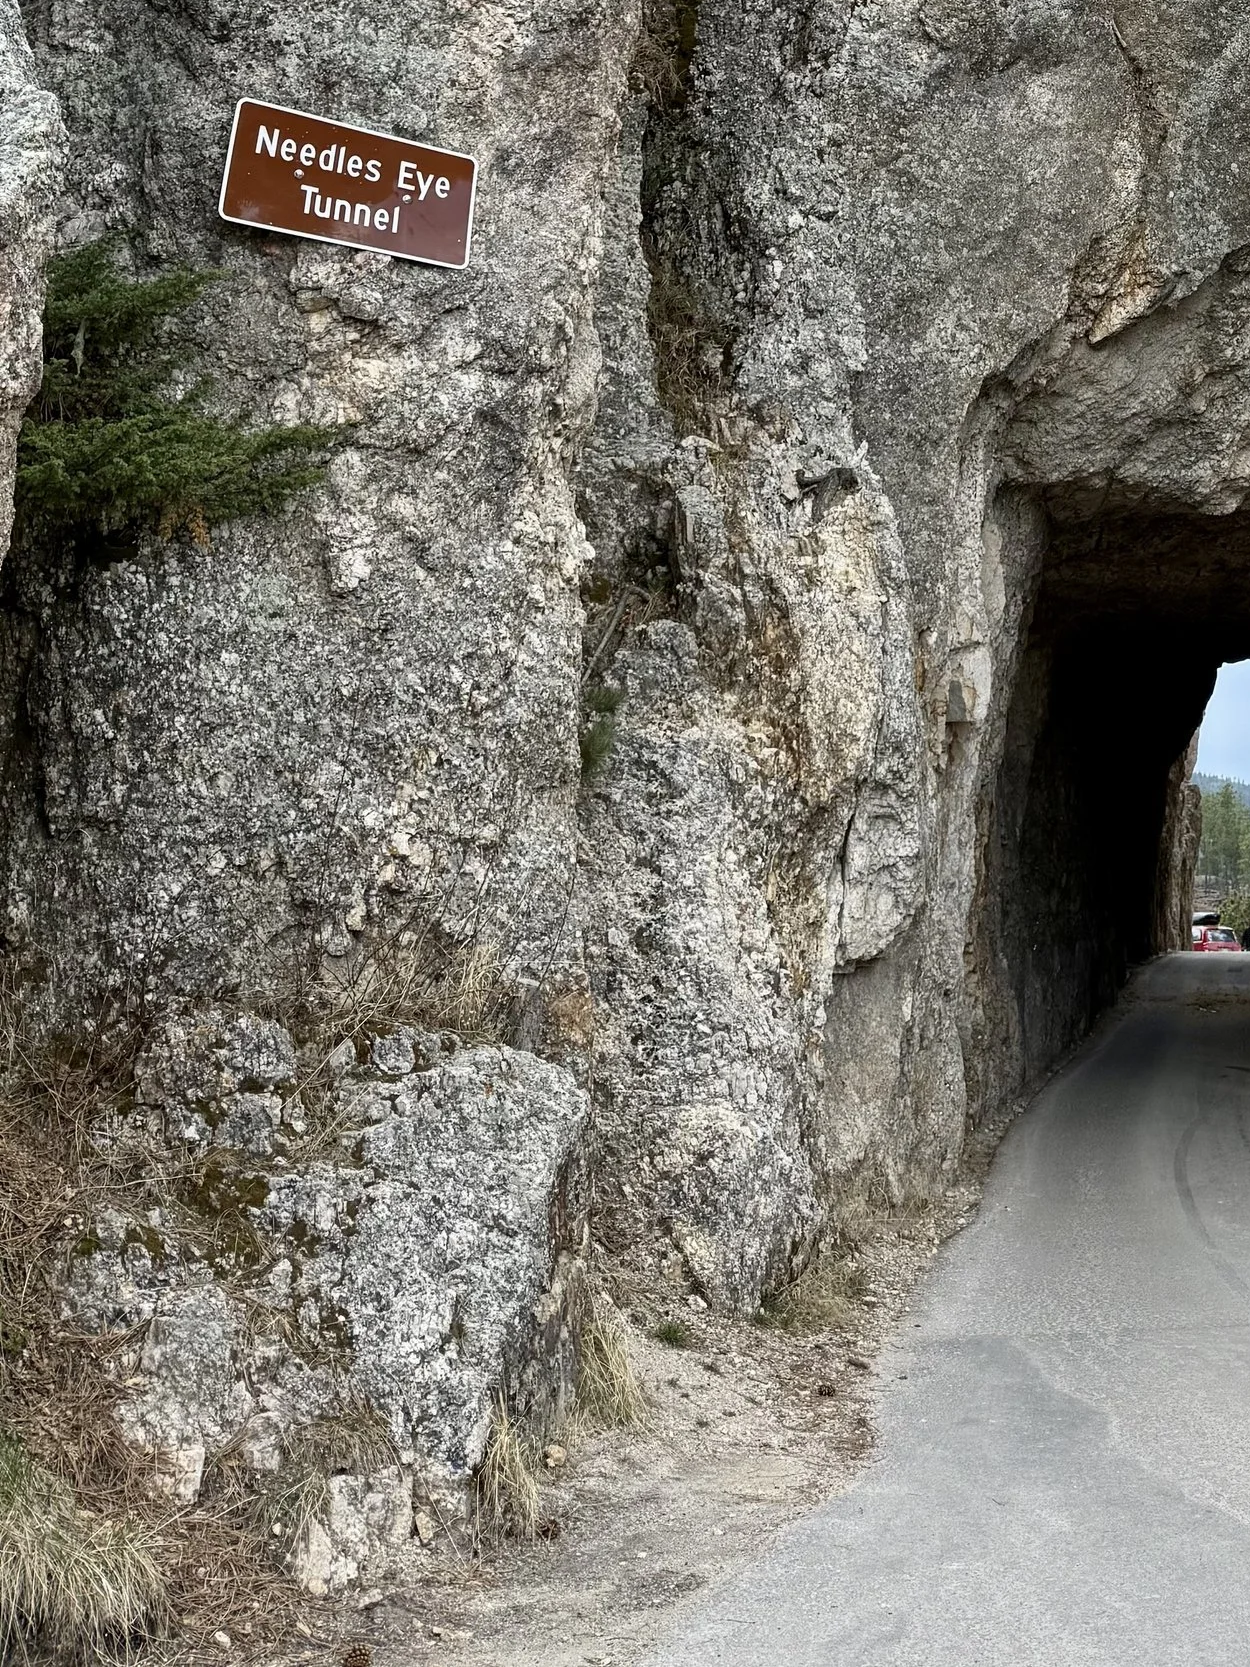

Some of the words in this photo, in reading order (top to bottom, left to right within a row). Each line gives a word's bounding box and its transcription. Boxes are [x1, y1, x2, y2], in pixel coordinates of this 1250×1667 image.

[254, 124, 382, 183] Needles
[397, 160, 450, 201] Eye
[300, 184, 400, 234] Tunnel
